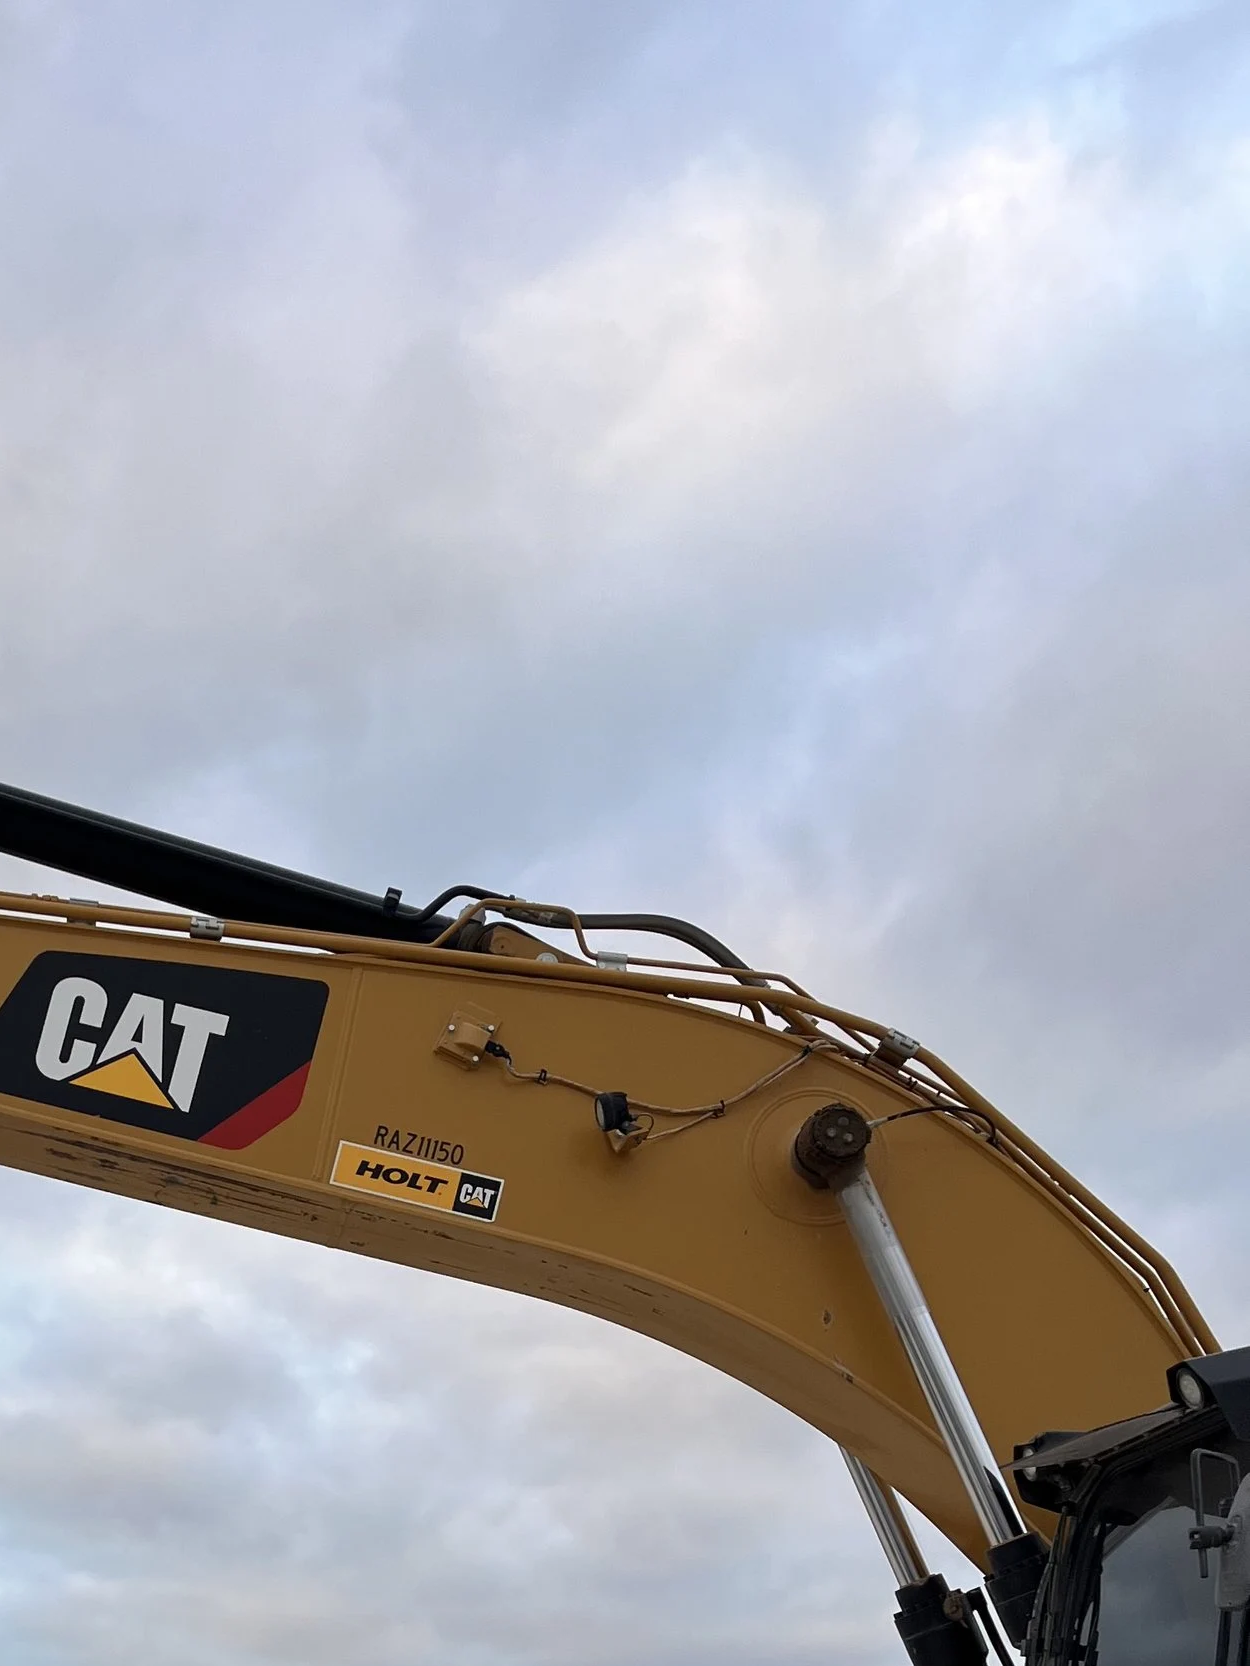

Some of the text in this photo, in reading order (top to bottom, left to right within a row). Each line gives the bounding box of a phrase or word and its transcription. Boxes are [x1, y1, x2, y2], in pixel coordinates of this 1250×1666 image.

[34, 976, 230, 1113] CAT
[373, 1125, 464, 1165] RAZ11150
[355, 1160, 495, 1209] HOLT CAT
